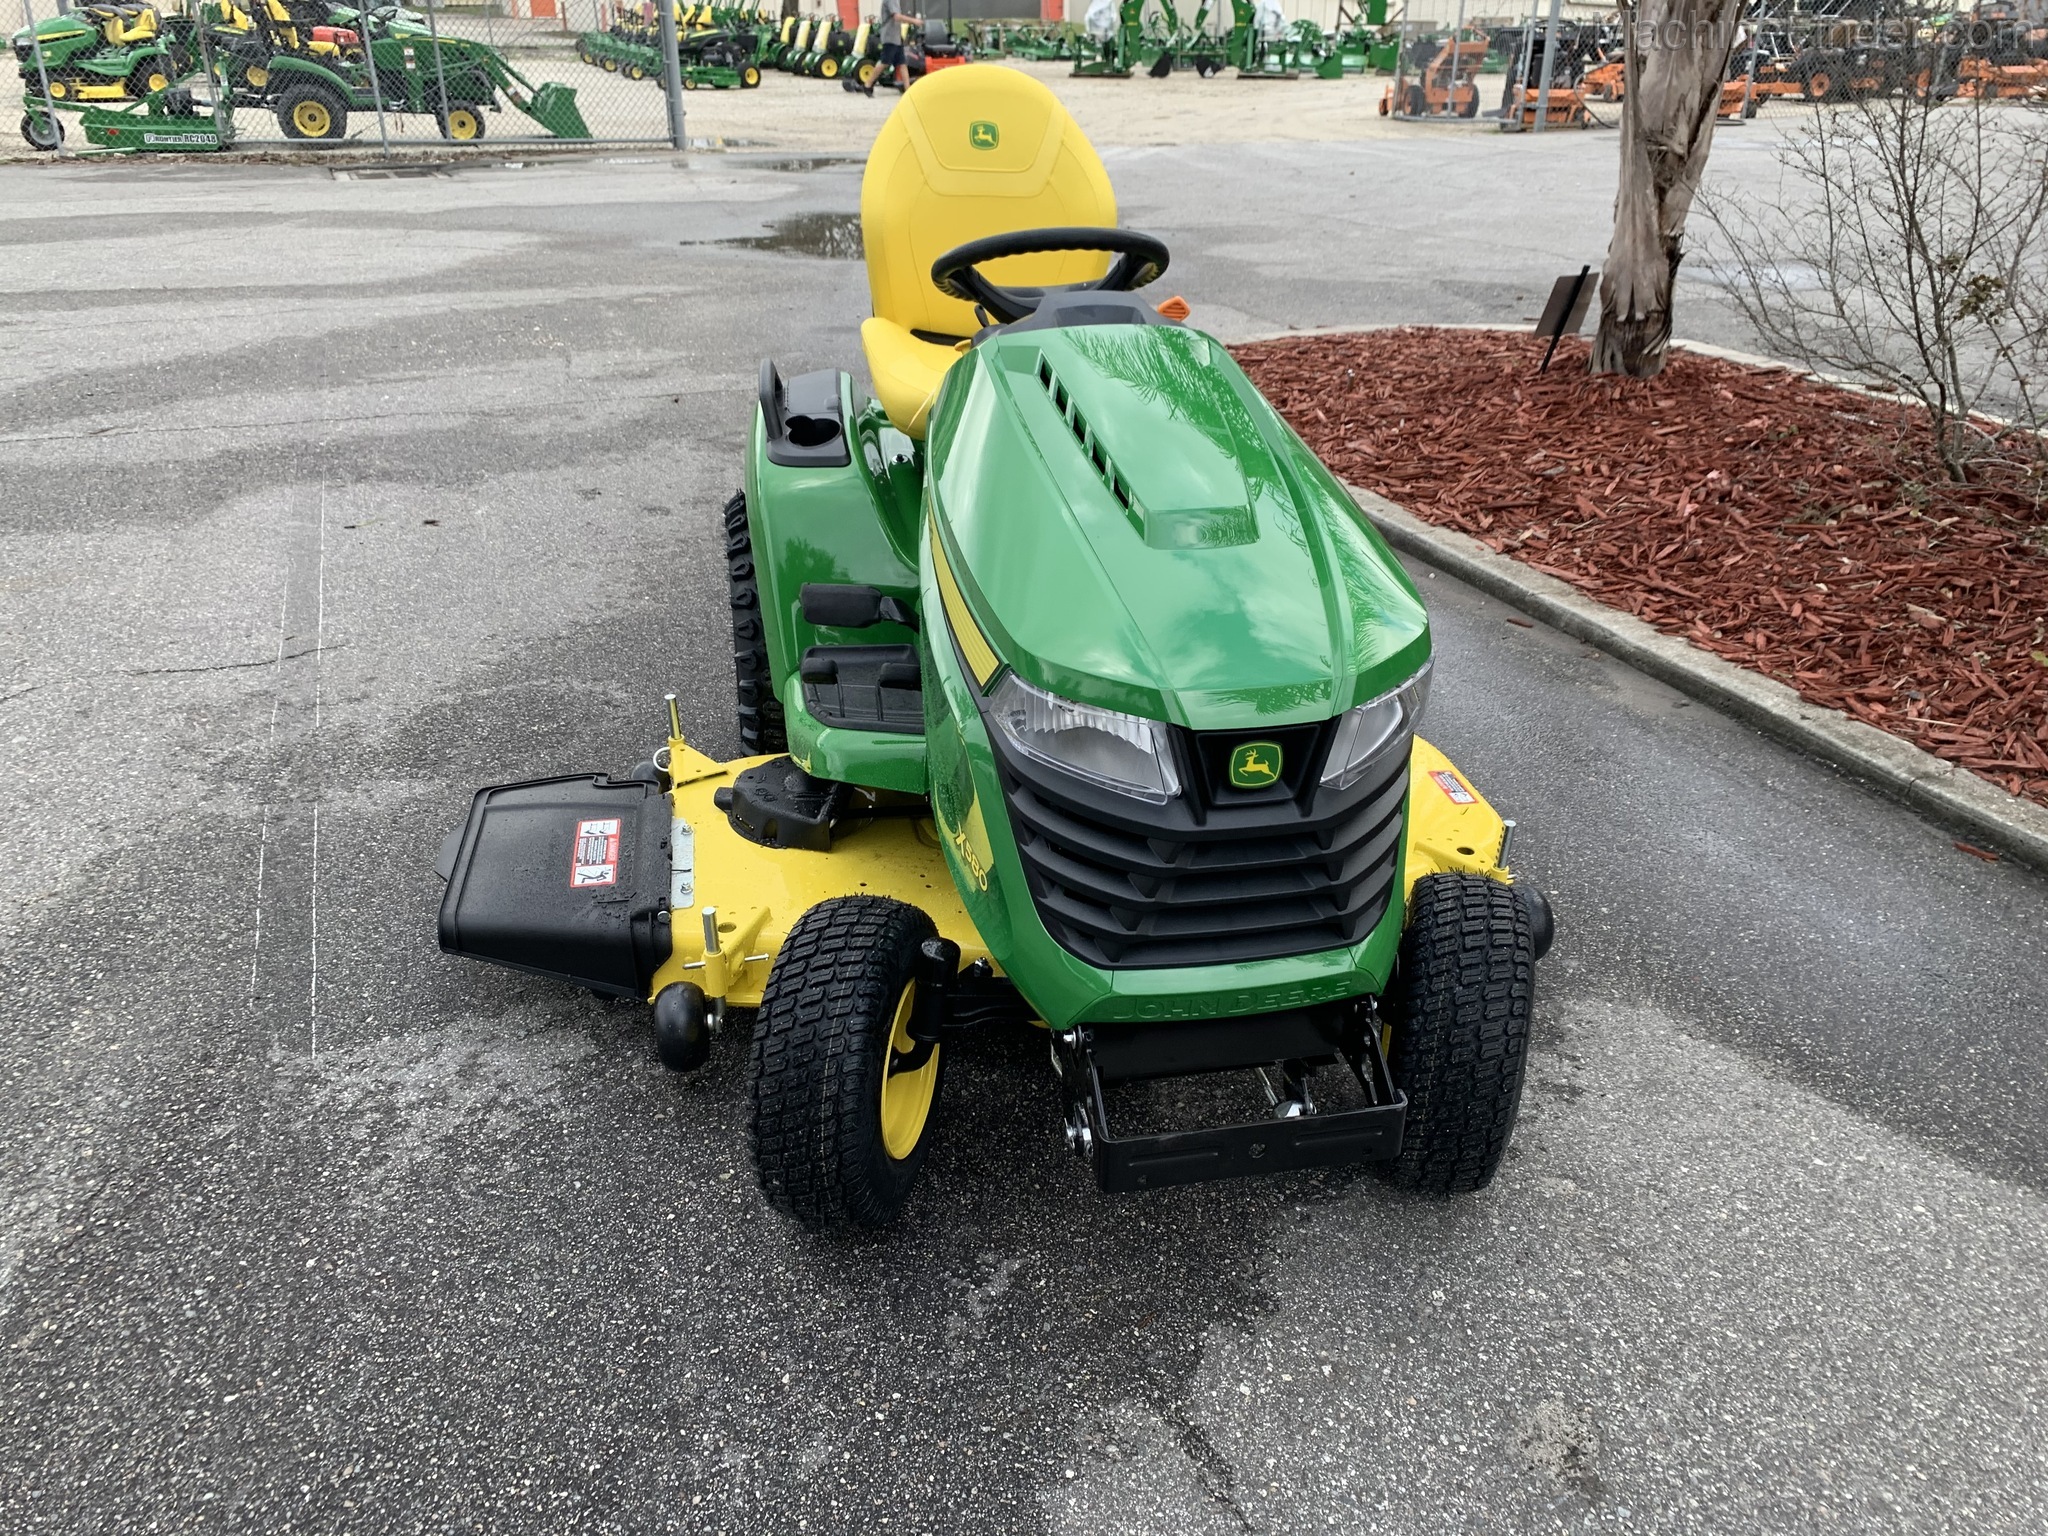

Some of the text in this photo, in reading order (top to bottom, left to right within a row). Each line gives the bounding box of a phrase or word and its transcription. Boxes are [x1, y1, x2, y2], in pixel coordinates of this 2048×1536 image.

[183, 134, 217, 143] RC2048
[955, 820, 988, 892] X580
[1113, 981, 1351, 1019] JOHN DEERE
